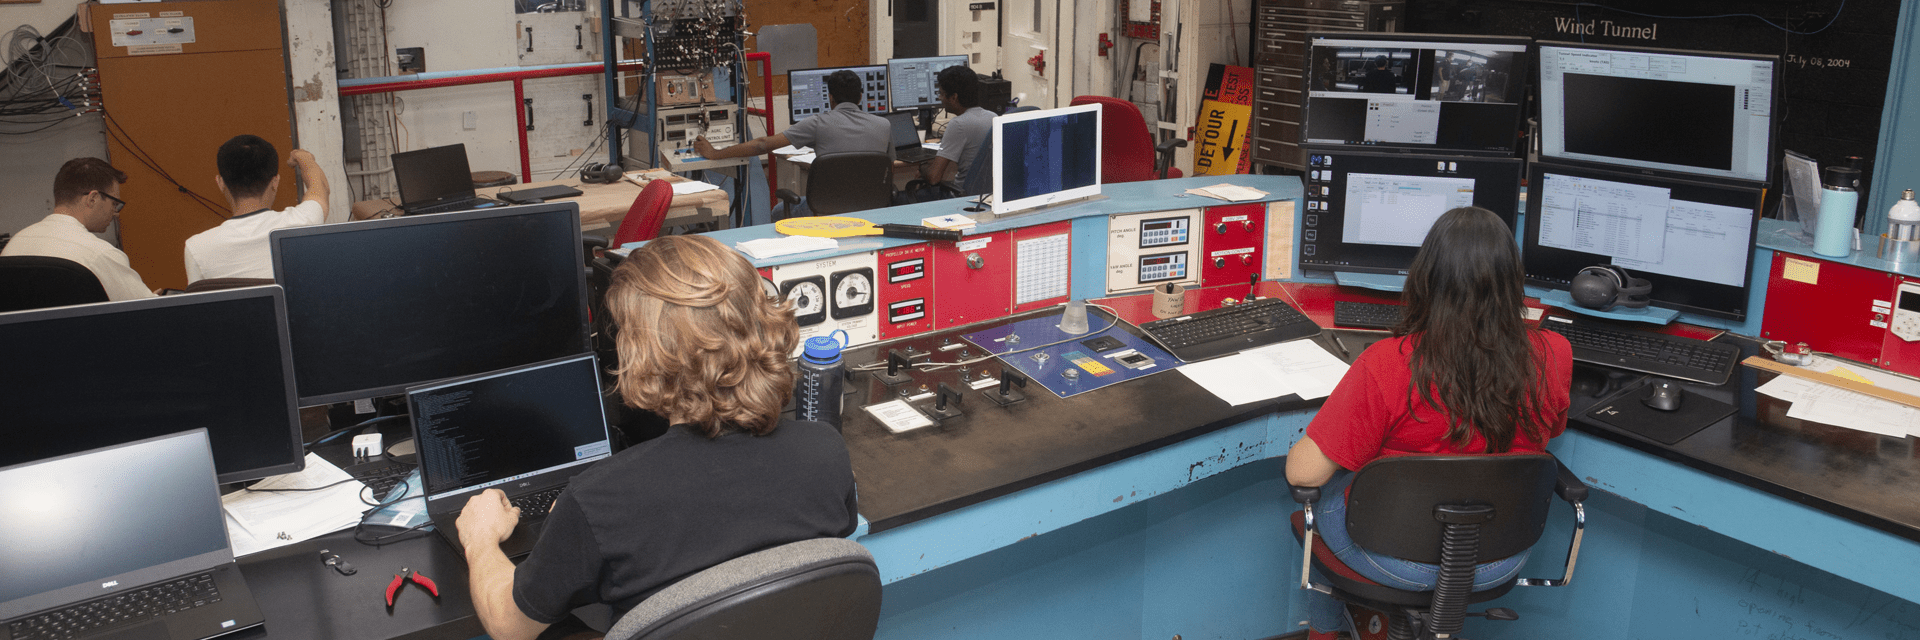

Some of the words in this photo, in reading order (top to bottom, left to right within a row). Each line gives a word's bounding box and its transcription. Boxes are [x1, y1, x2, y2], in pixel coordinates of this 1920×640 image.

[1554, 17, 1595, 35] Wind
[1601, 20, 1657, 40] Tunnel
[1786, 54, 1807, 69] July
[1827, 58, 1851, 68] 2004
[1224, 72, 1239, 96] TEST
[1237, 88, 1250, 105] SS
[1197, 109, 1225, 168] DETOUR
[816, 260, 837, 269] SYSTEM
[102, 580, 119, 589] DELL
